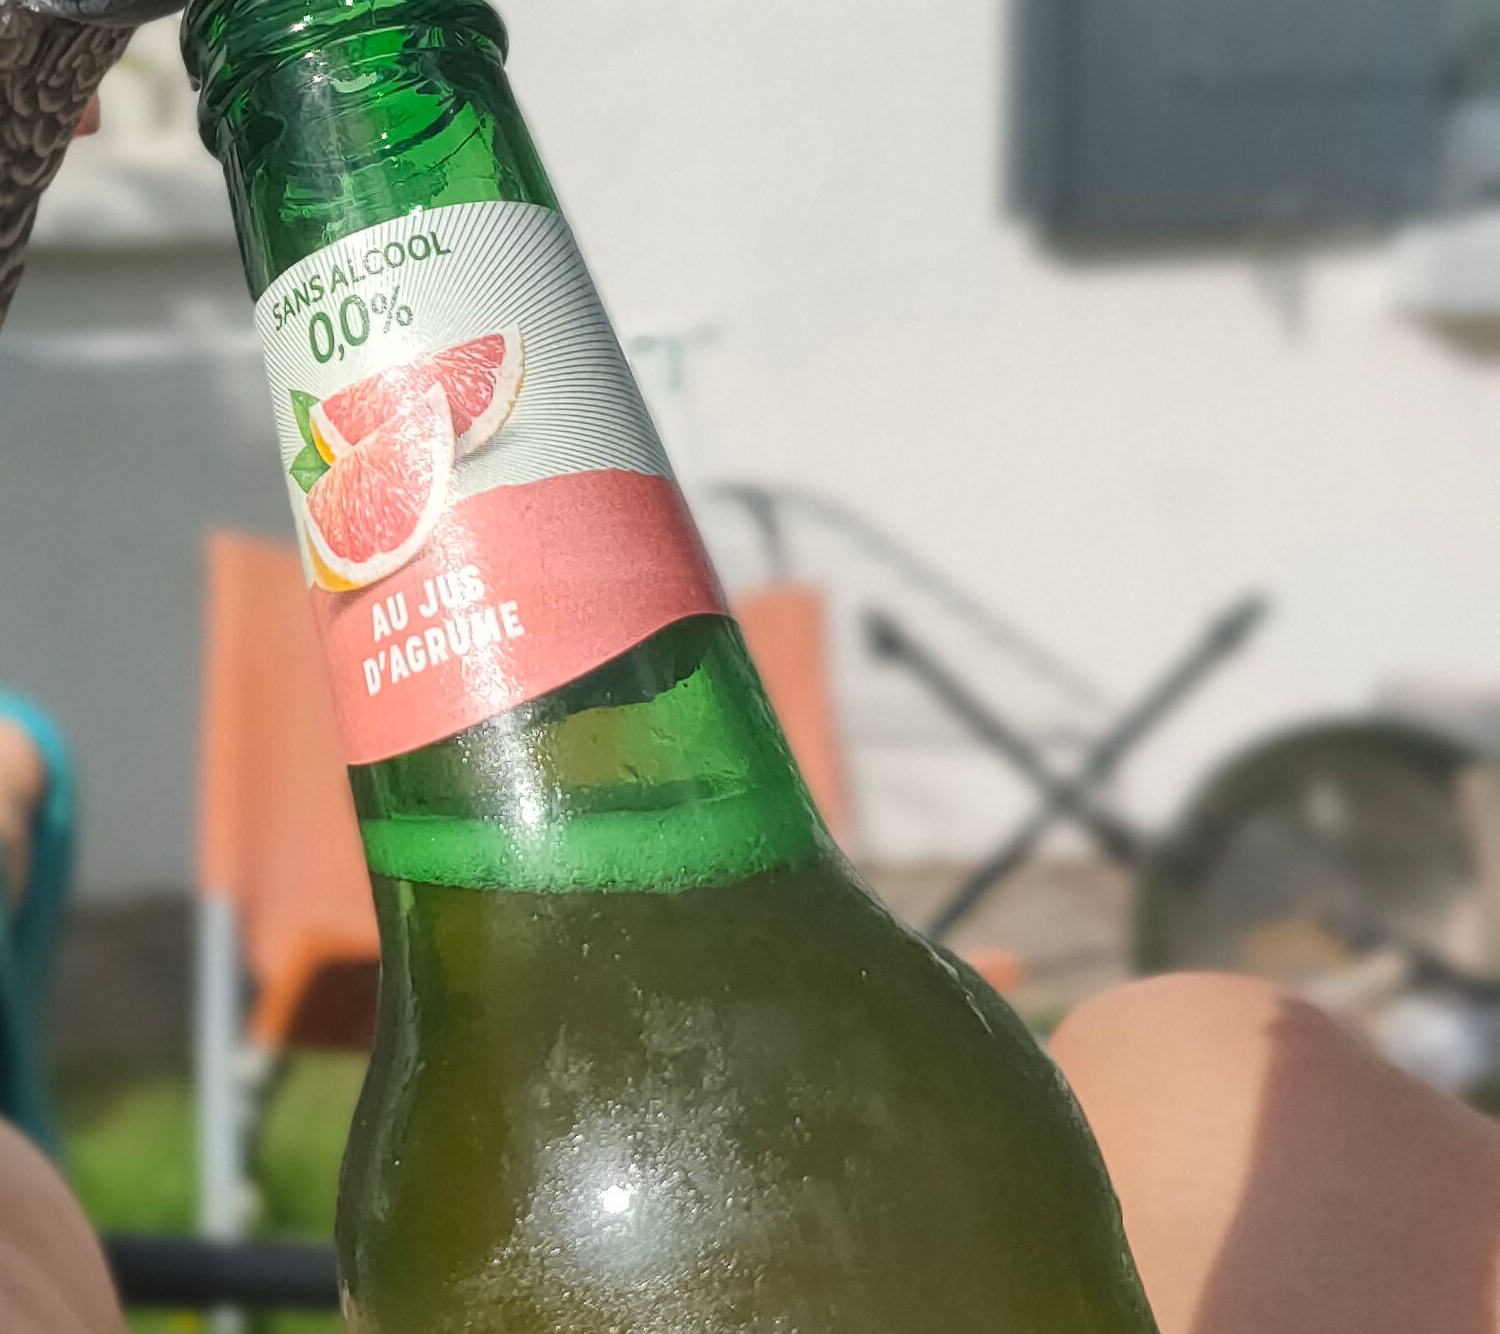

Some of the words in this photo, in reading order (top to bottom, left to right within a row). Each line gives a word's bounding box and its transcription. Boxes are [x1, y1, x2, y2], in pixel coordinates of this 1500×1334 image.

[273, 274, 324, 331] SANS
[330, 231, 451, 293] ALCOOL
[309, 285, 413, 364] 0,0%
[372, 590, 409, 643] AU
[418, 564, 485, 618] JUS
[362, 600, 525, 697] D'AGRUME
